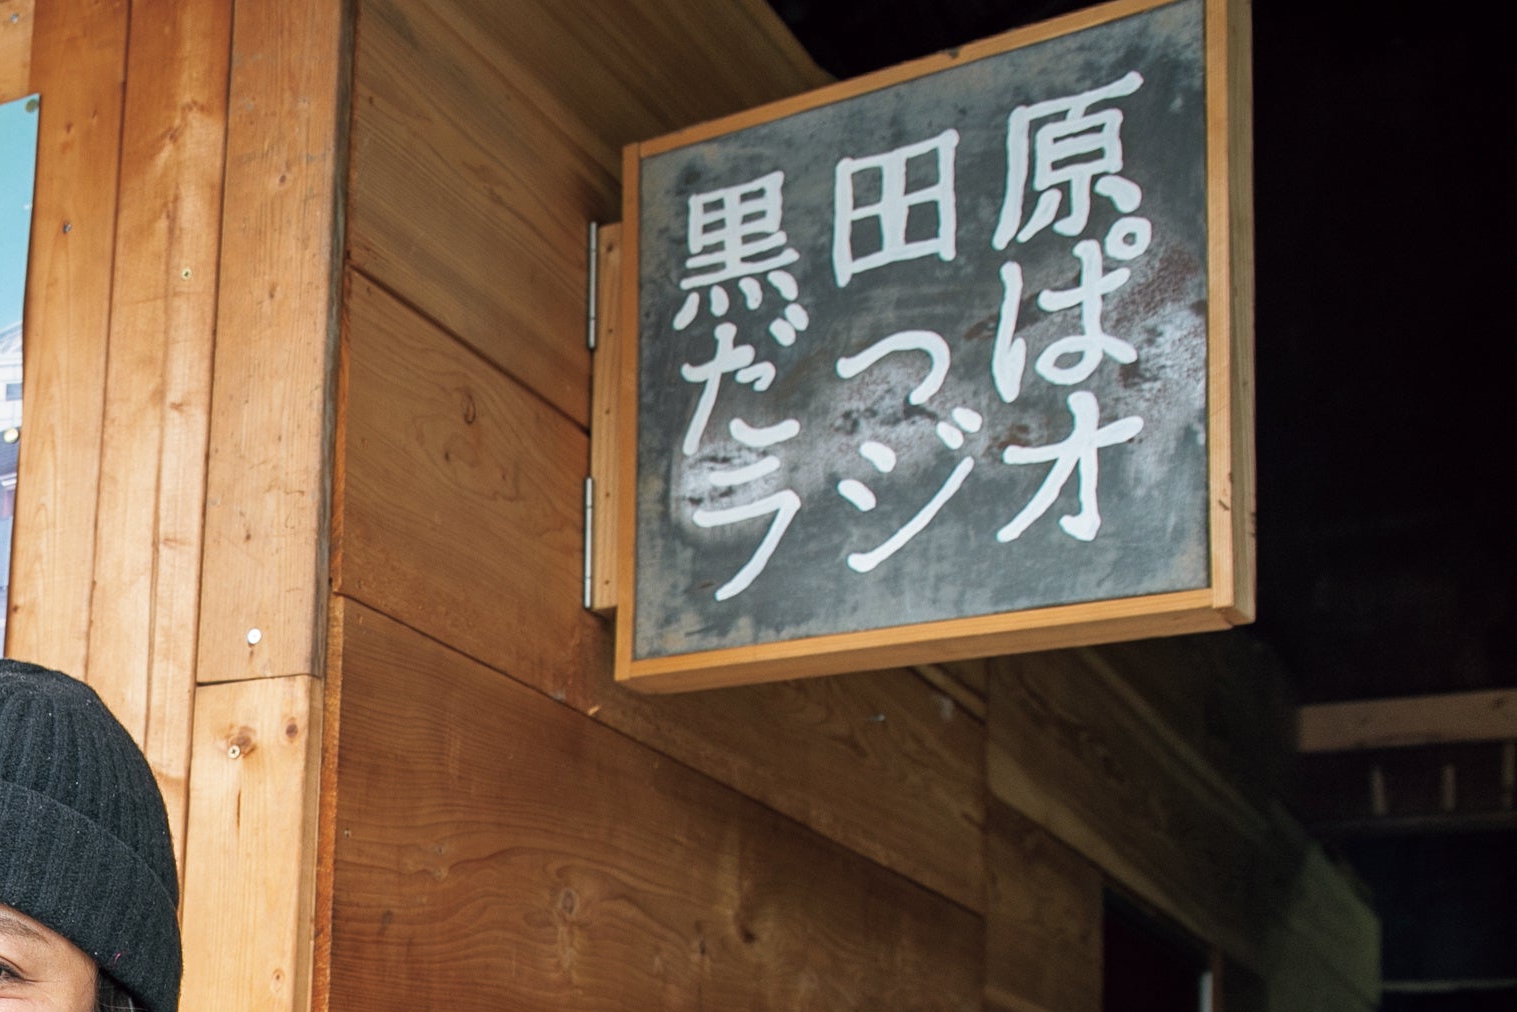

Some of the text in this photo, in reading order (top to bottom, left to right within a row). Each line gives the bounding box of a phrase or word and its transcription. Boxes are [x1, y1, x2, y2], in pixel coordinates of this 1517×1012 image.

[674, 70, 1144, 330] 黒田原
[691, 390, 1144, 602] ラジオ
